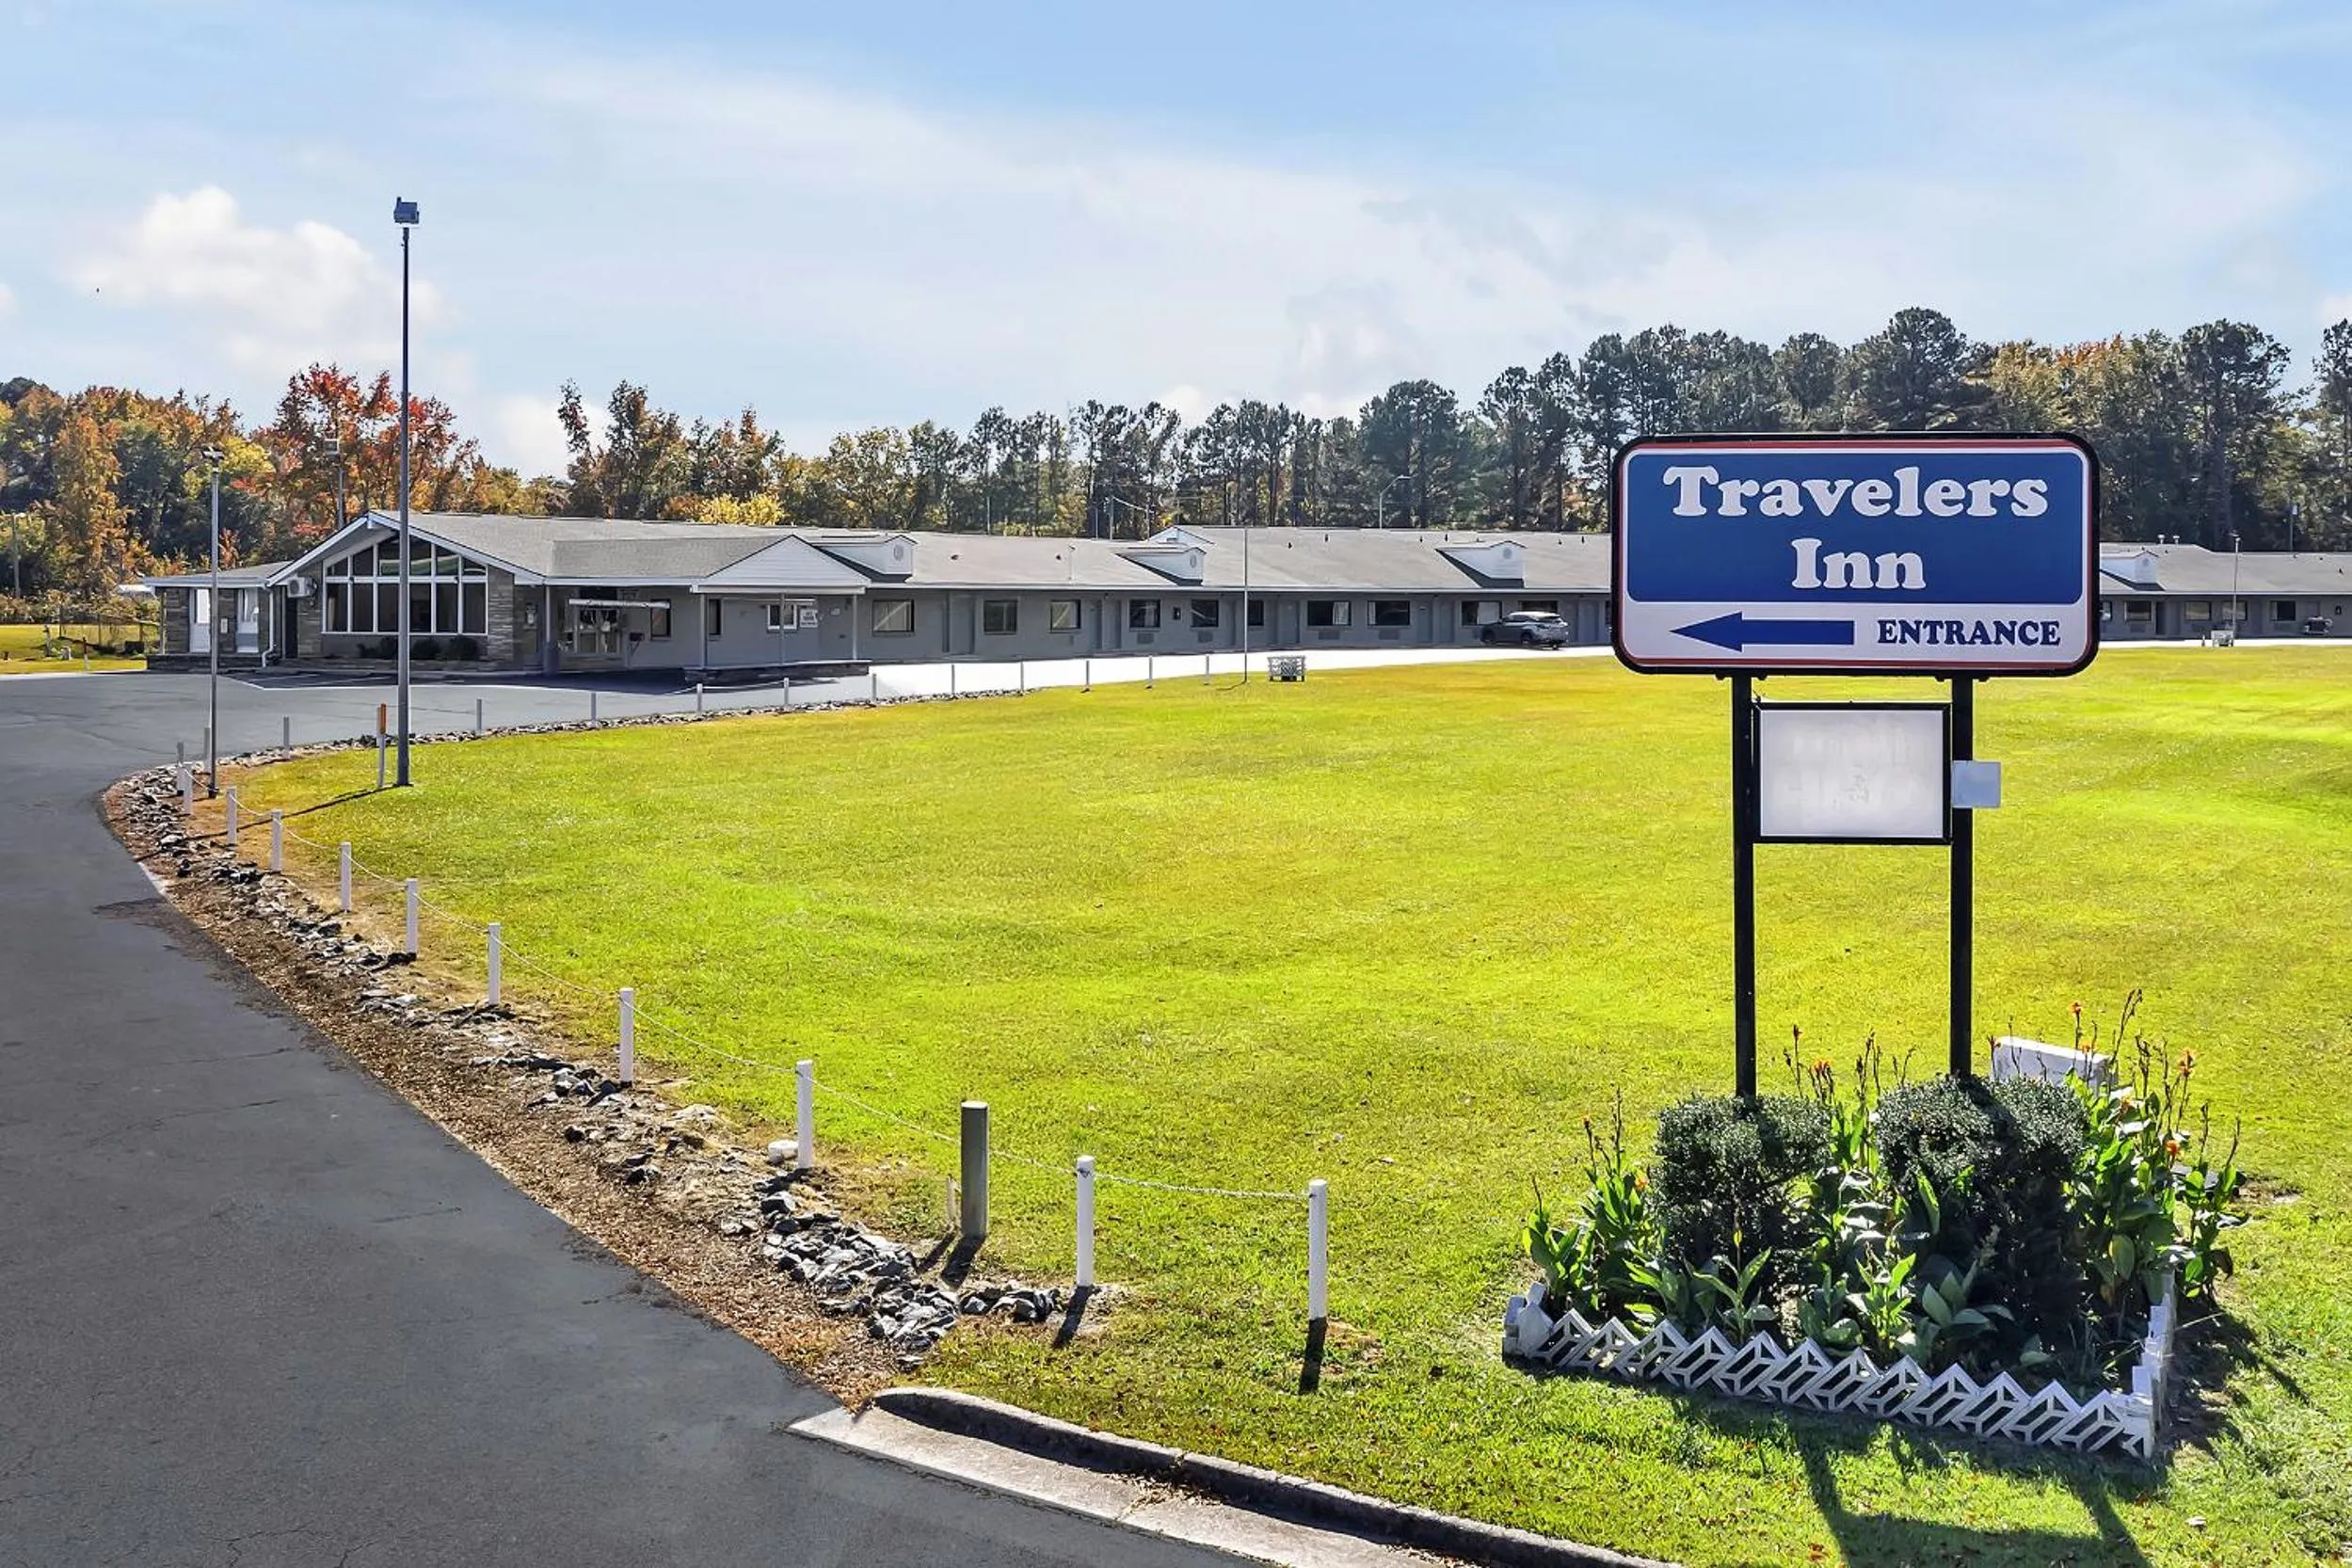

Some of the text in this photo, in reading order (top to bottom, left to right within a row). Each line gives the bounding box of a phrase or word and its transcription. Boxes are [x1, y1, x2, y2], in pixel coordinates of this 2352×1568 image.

[1663, 466, 2048, 517] Travelers
[1791, 538, 1927, 590] Inn
[1878, 619, 2061, 647] ENTRANCE
